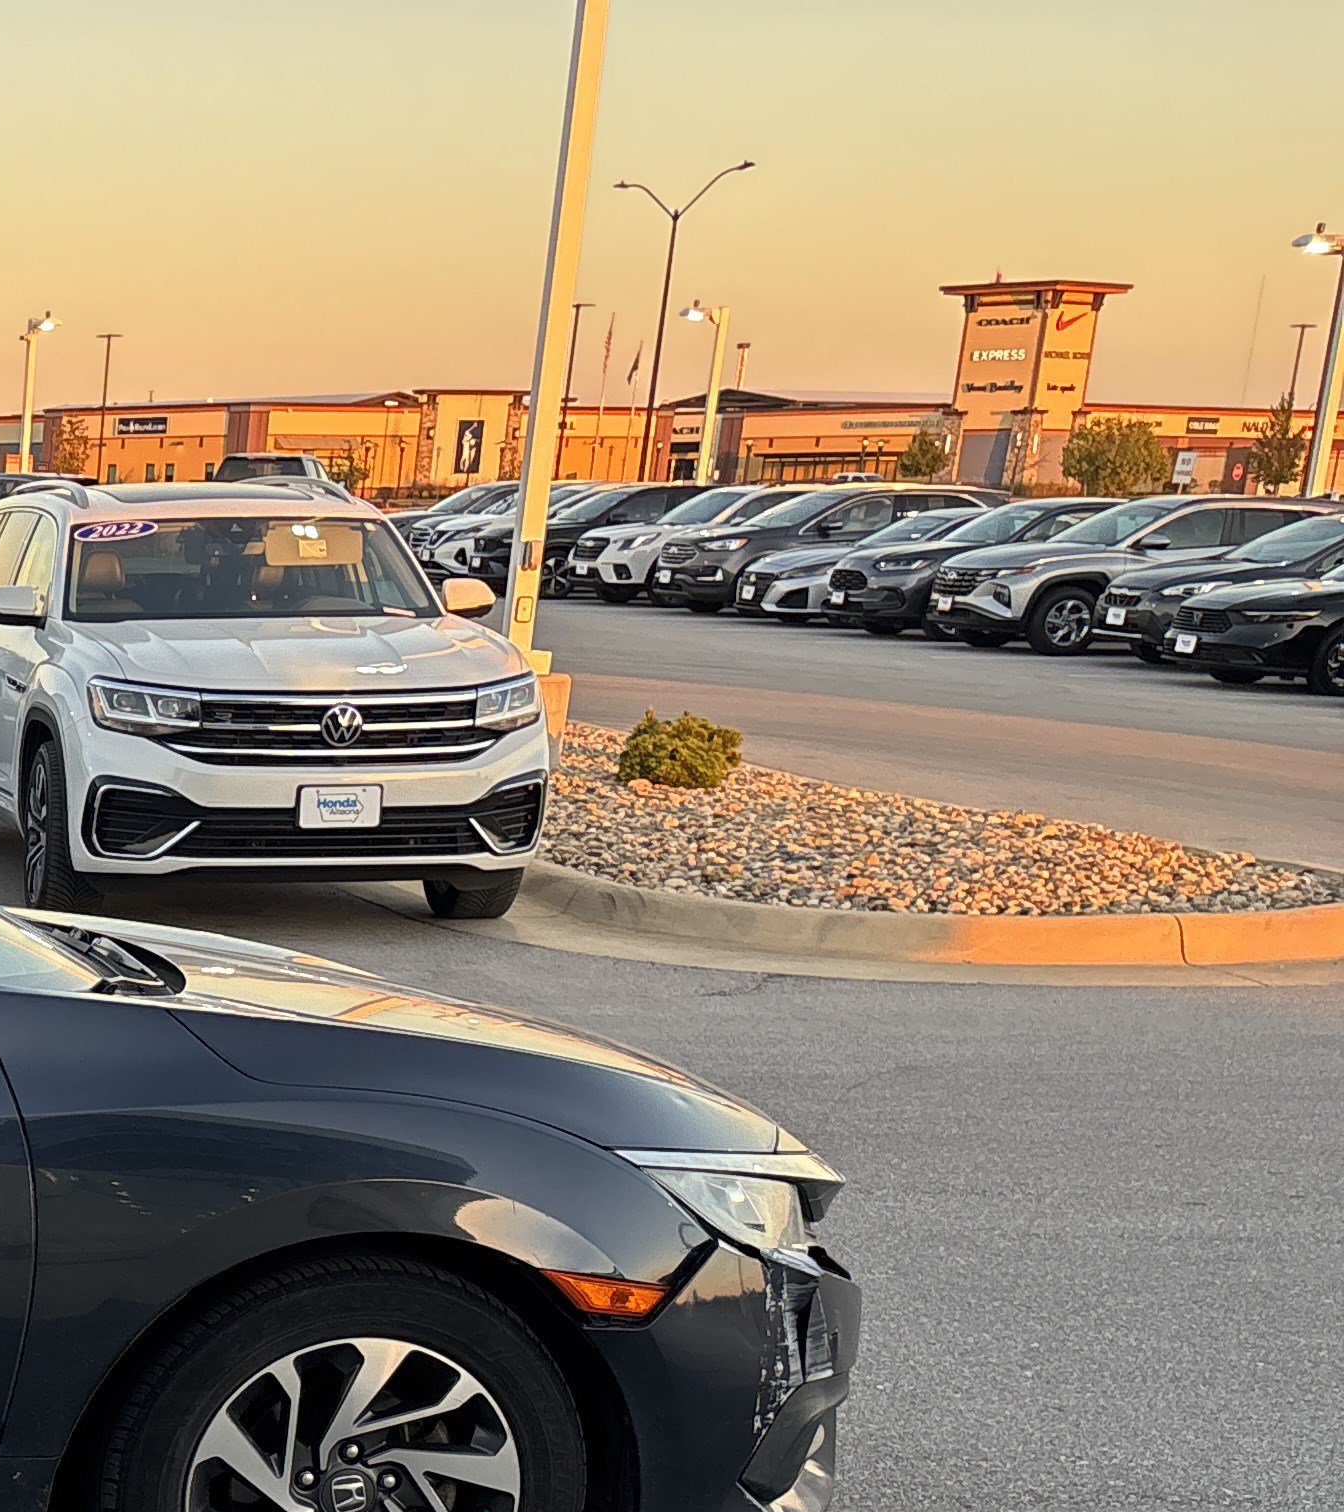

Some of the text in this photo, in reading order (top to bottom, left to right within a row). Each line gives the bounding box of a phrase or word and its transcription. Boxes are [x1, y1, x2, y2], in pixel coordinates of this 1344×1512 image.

[976, 317, 1032, 327] COACH
[971, 349, 1026, 361] EXPRESS
[89, 523, 143, 538] 2022
[317, 798, 357, 808] Honda
